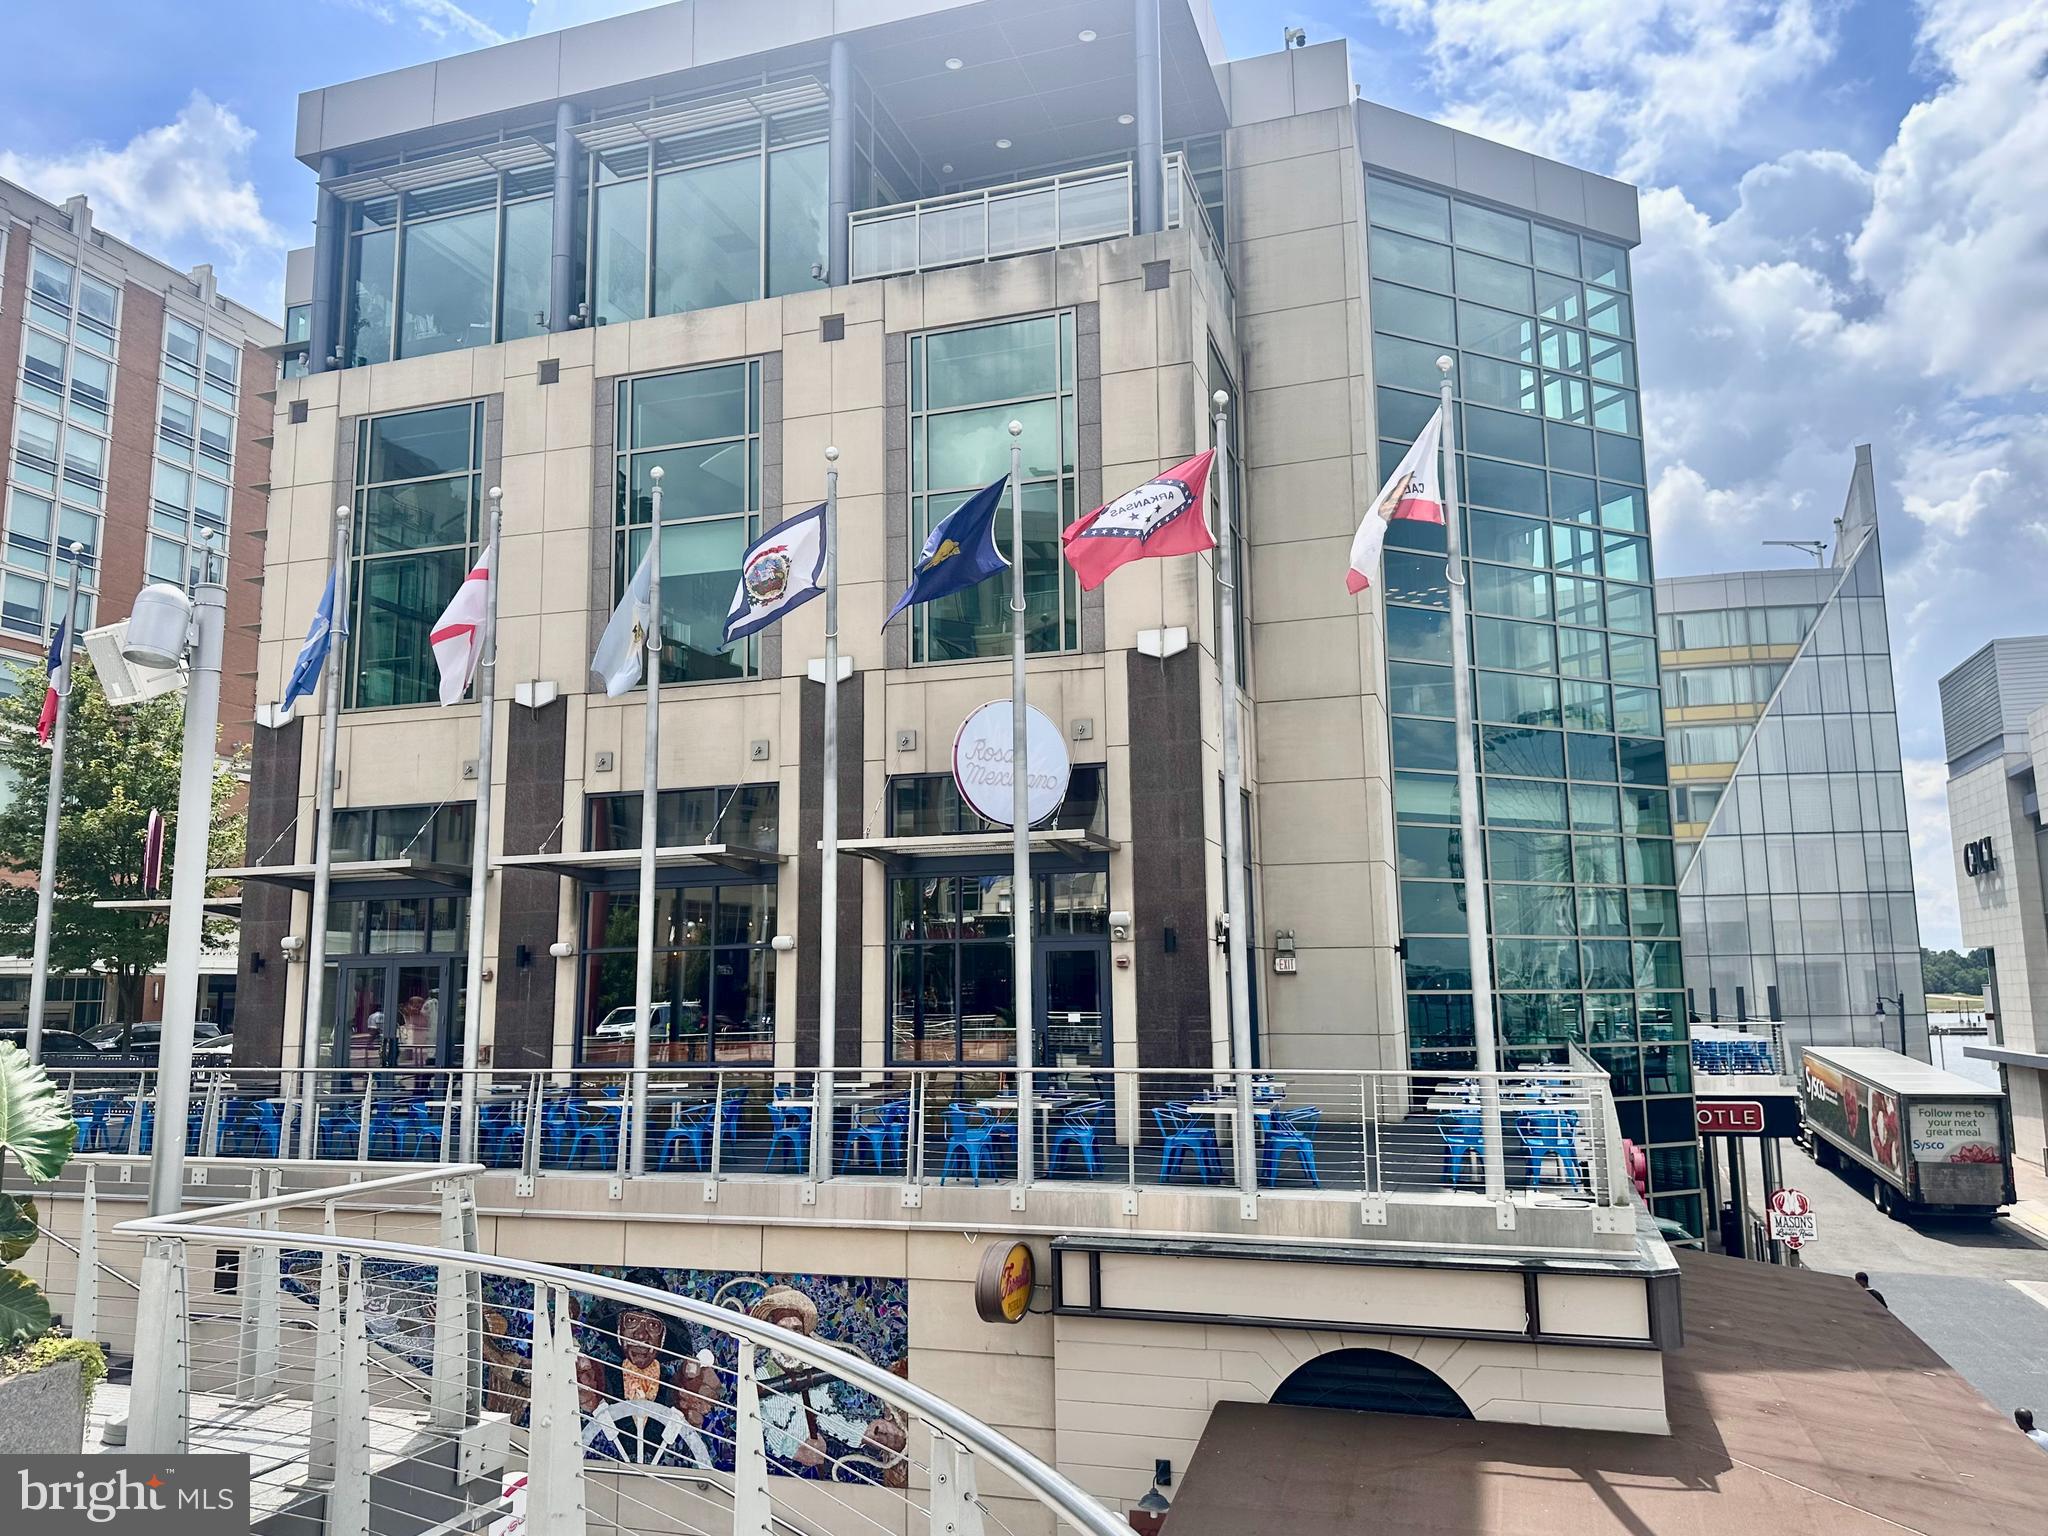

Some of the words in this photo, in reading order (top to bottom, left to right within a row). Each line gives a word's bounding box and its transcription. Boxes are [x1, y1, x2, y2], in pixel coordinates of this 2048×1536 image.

[965, 738, 1014, 764] Rosa
[966, 762, 1058, 790] Mexiano
[1279, 958, 1294, 970] EXIT
[1696, 1109, 1757, 1125] OTLE
[1918, 1108, 1953, 1118] Follow
[1955, 1110, 1971, 1118] me
[1974, 1109, 1985, 1118] to
[1928, 1120, 1952, 1129] your
[1954, 1119, 1977, 1127] next
[1925, 1128, 1953, 1138] great
[1956, 1127, 1981, 1137] meal
[1913, 1139, 1945, 1151] Sysco
